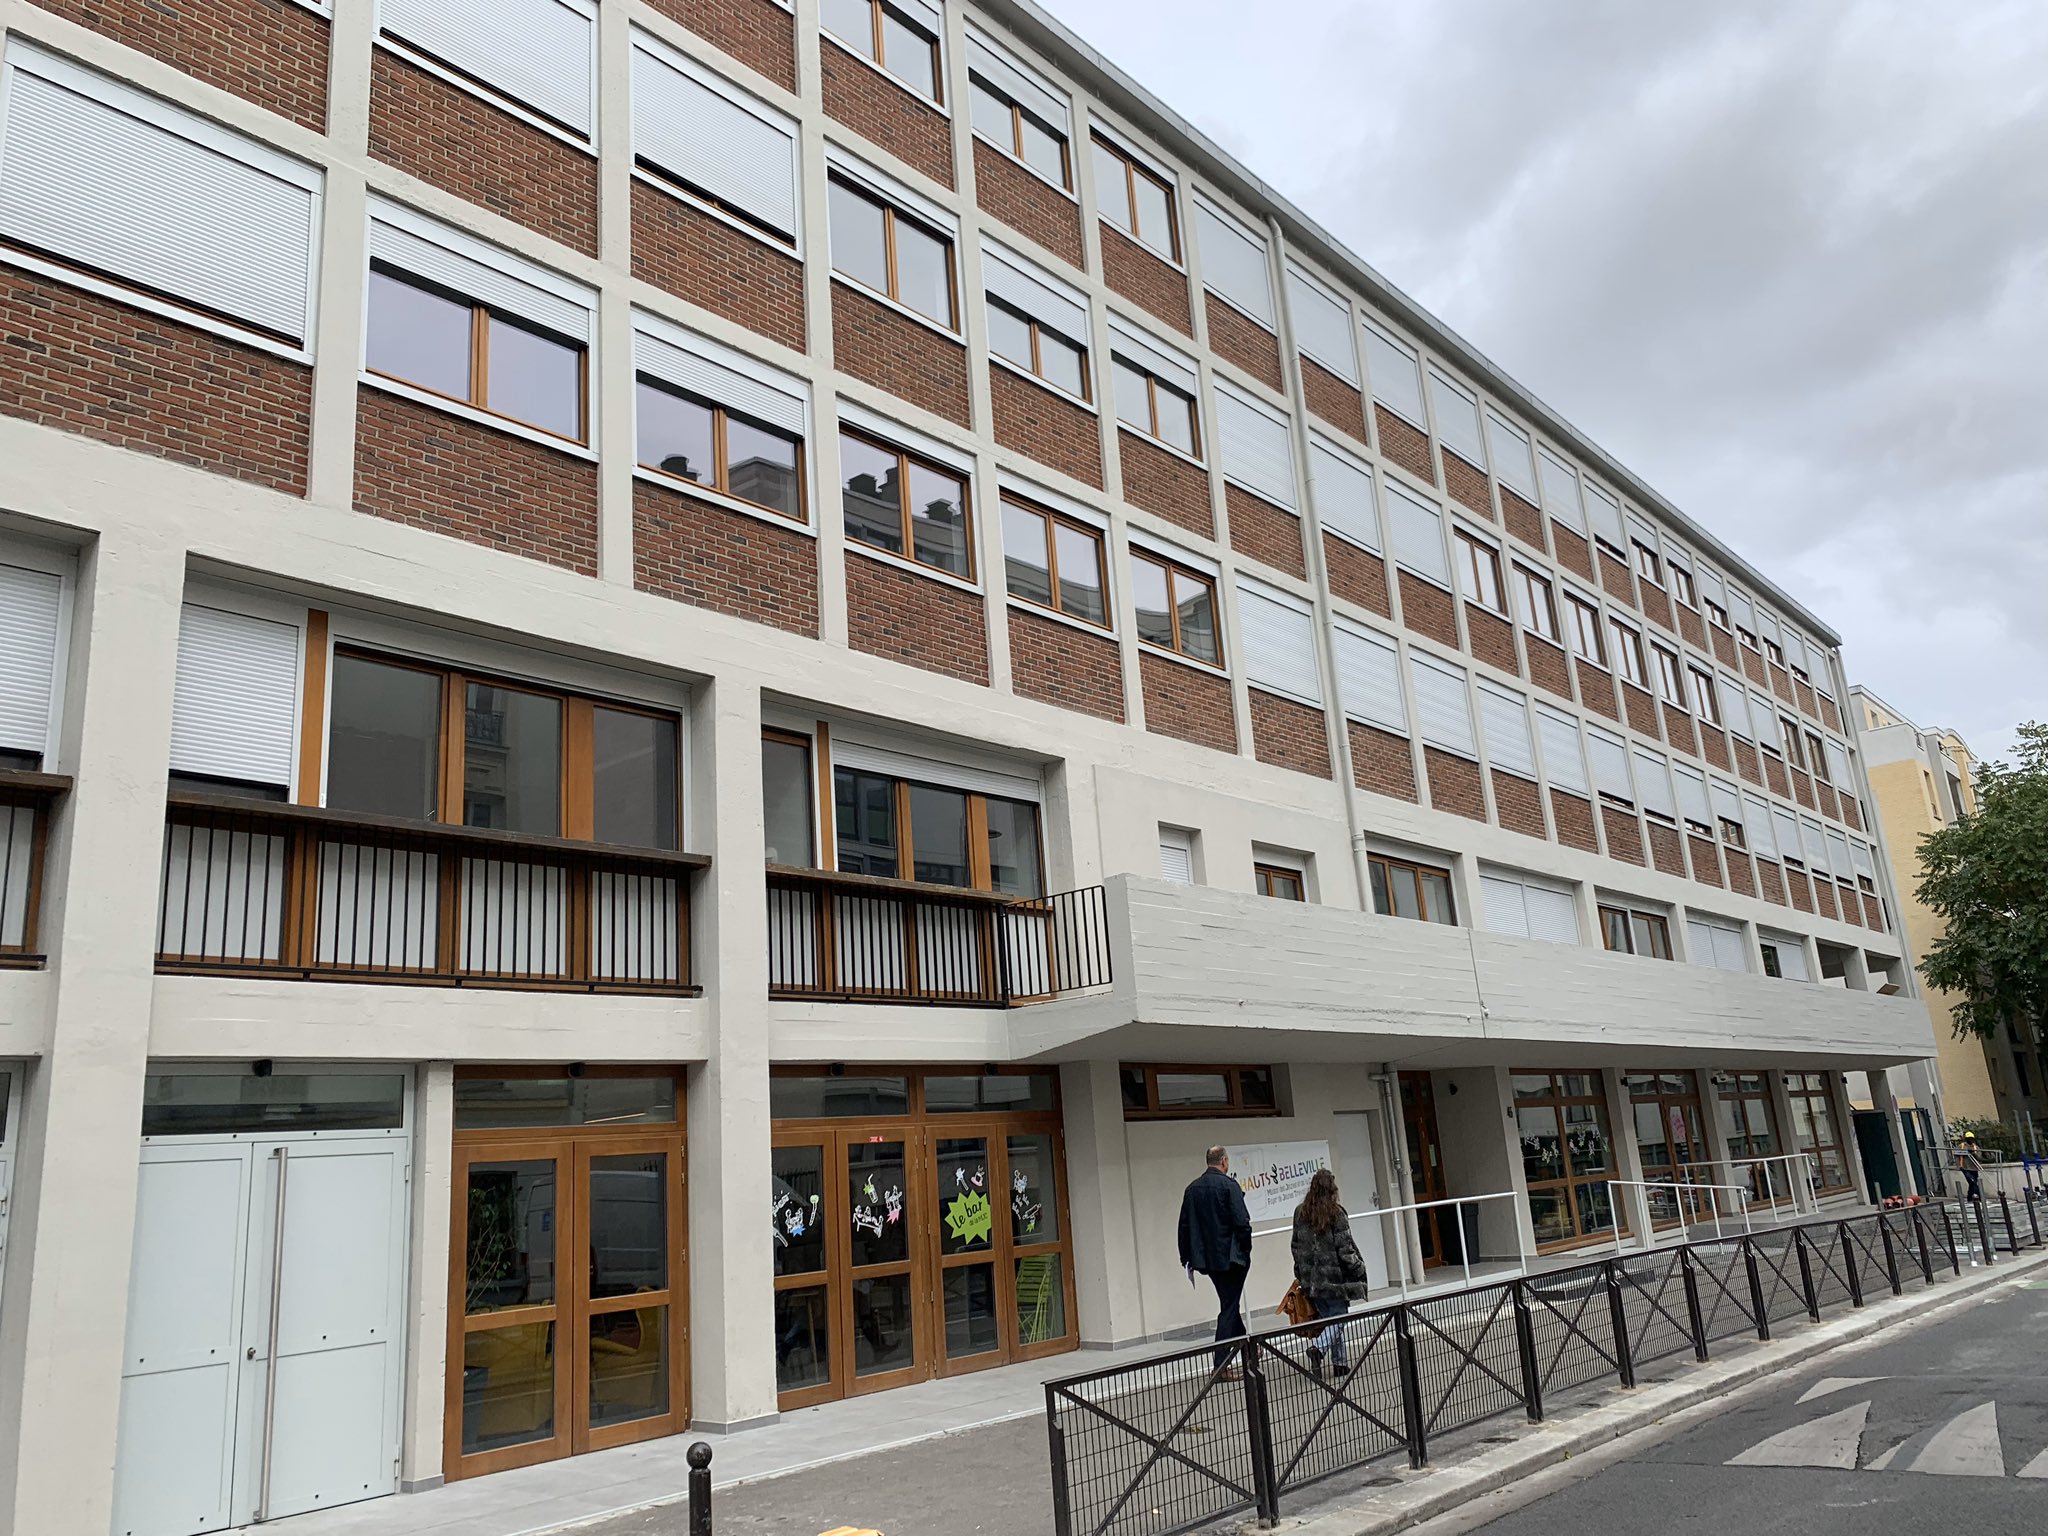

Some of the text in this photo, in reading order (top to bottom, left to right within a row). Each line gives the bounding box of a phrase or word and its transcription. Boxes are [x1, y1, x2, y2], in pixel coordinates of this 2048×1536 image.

[1241, 1172, 1271, 1191] HAUTS
[1279, 1157, 1325, 1181] BELLEVILLE
[964, 1201, 982, 1217] bar
